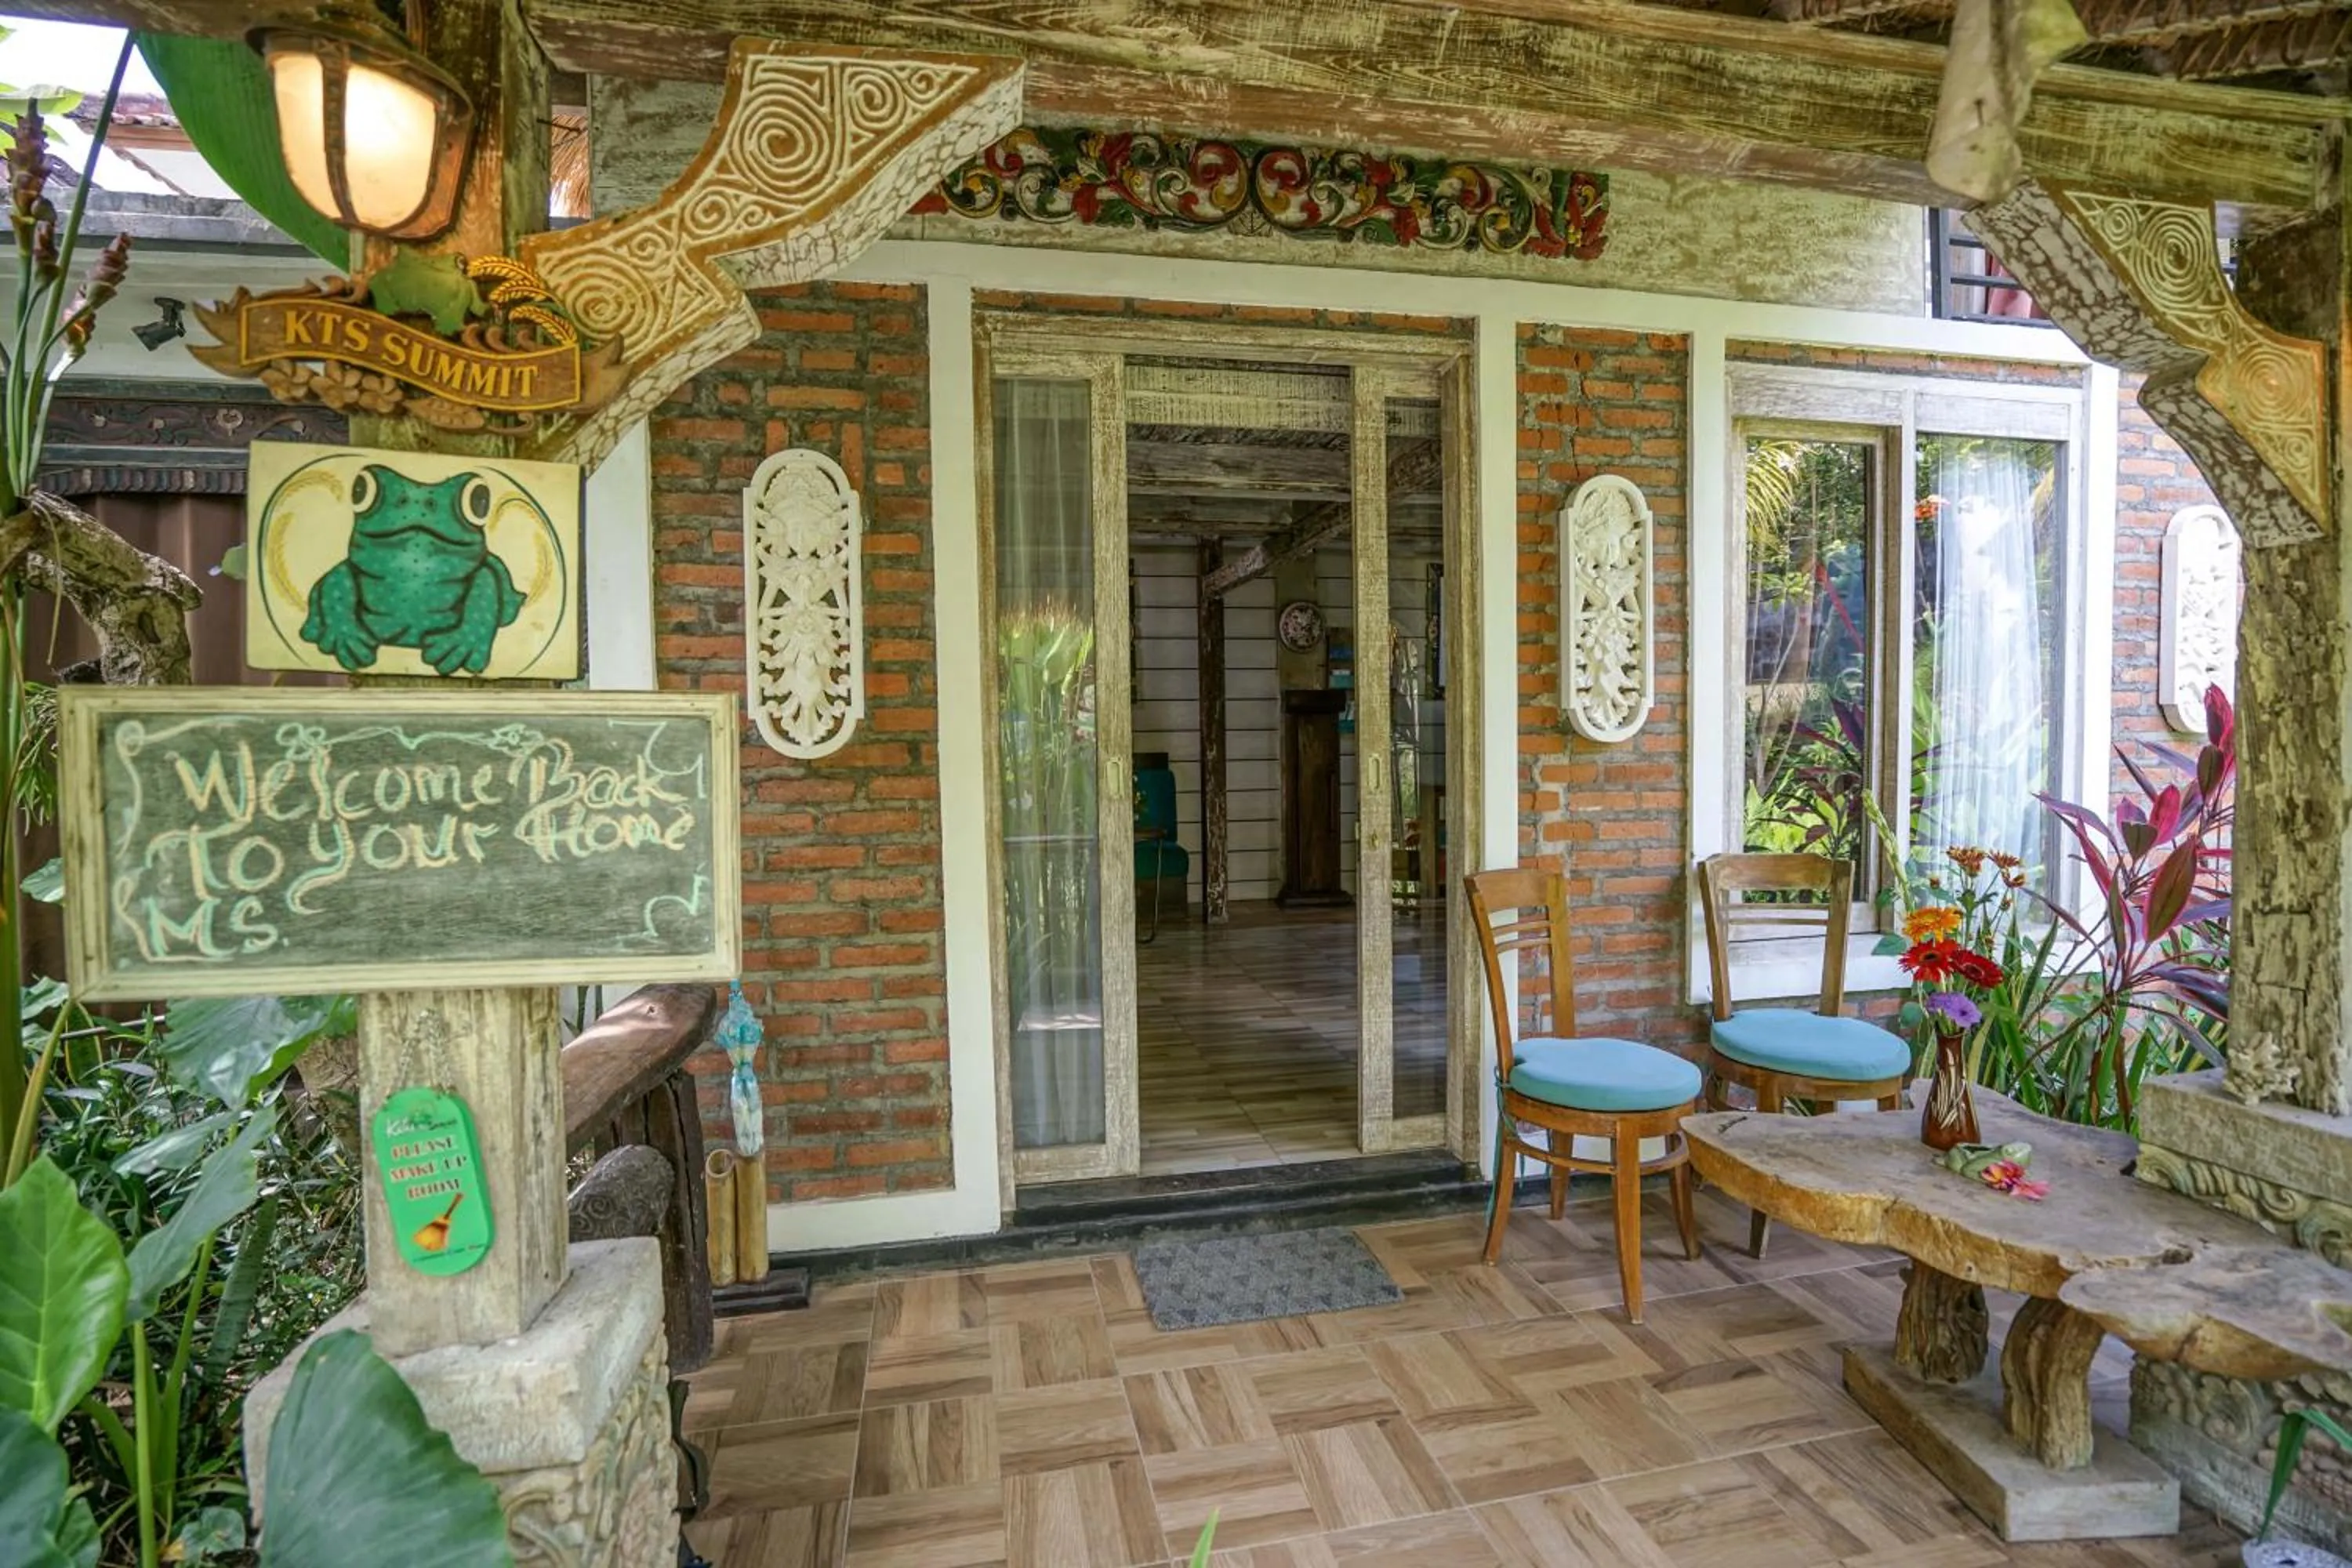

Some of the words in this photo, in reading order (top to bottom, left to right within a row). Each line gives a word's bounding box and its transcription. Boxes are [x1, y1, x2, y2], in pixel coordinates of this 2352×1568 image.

[285, 310, 370, 352] KTS
[381, 328, 539, 398] SUMMIT
[166, 740, 504, 822] Welcome
[508, 738, 688, 808] Back
[286, 818, 500, 915] your
[514, 801, 695, 862] Home
[390, 1161, 436, 1181] MAKE
[441, 1155, 468, 1171] UP
[392, 1135, 456, 1159] PLEASE
[408, 1178, 460, 1200] ROOM
